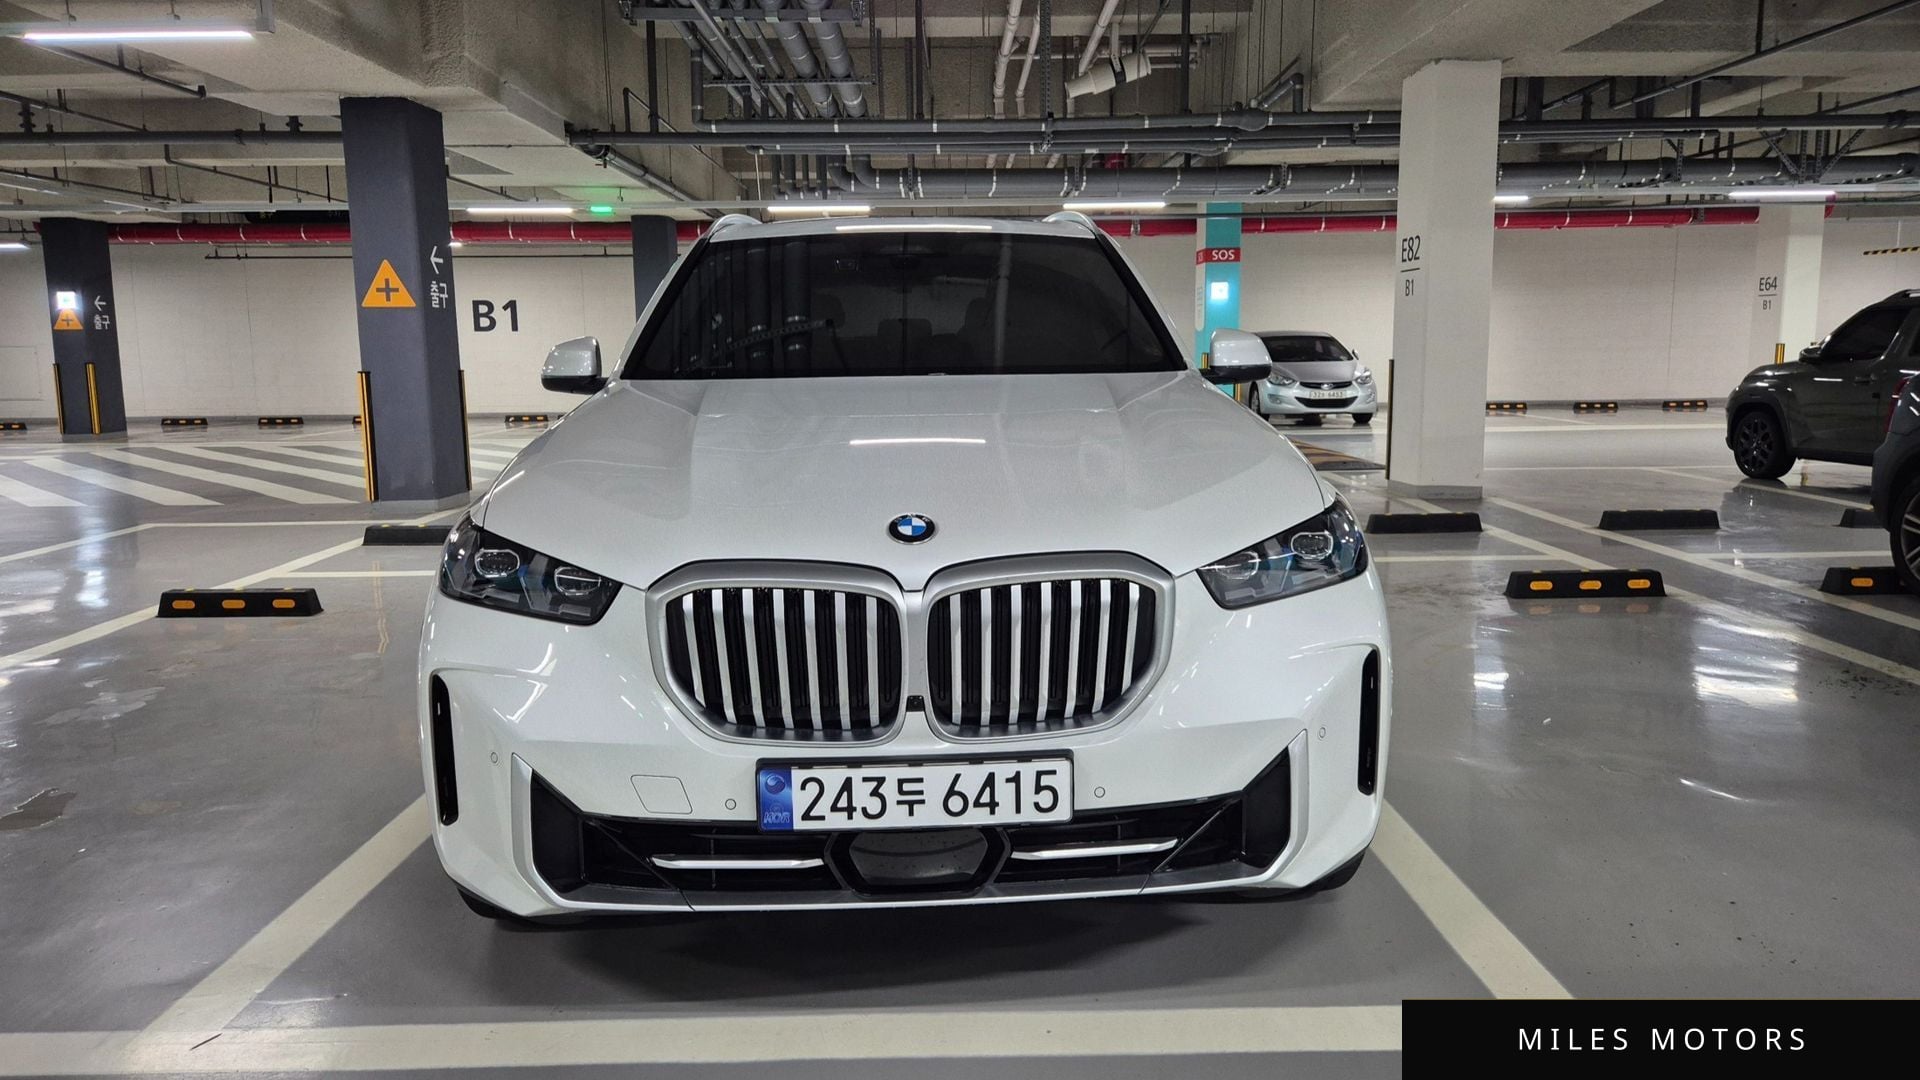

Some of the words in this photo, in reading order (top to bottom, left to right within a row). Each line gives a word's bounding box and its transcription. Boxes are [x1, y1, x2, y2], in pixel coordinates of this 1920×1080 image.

[1212, 249, 1235, 261] SOS
[1401, 235, 1421, 263] E82
[430, 281, 448, 309] 출구
[1405, 279, 1414, 297] B1
[1759, 276, 1777, 291] E64
[472, 299, 519, 332] B1
[1762, 299, 1772, 310] B1
[800, 776, 926, 821] 243두
[942, 769, 1060, 817] 6415
